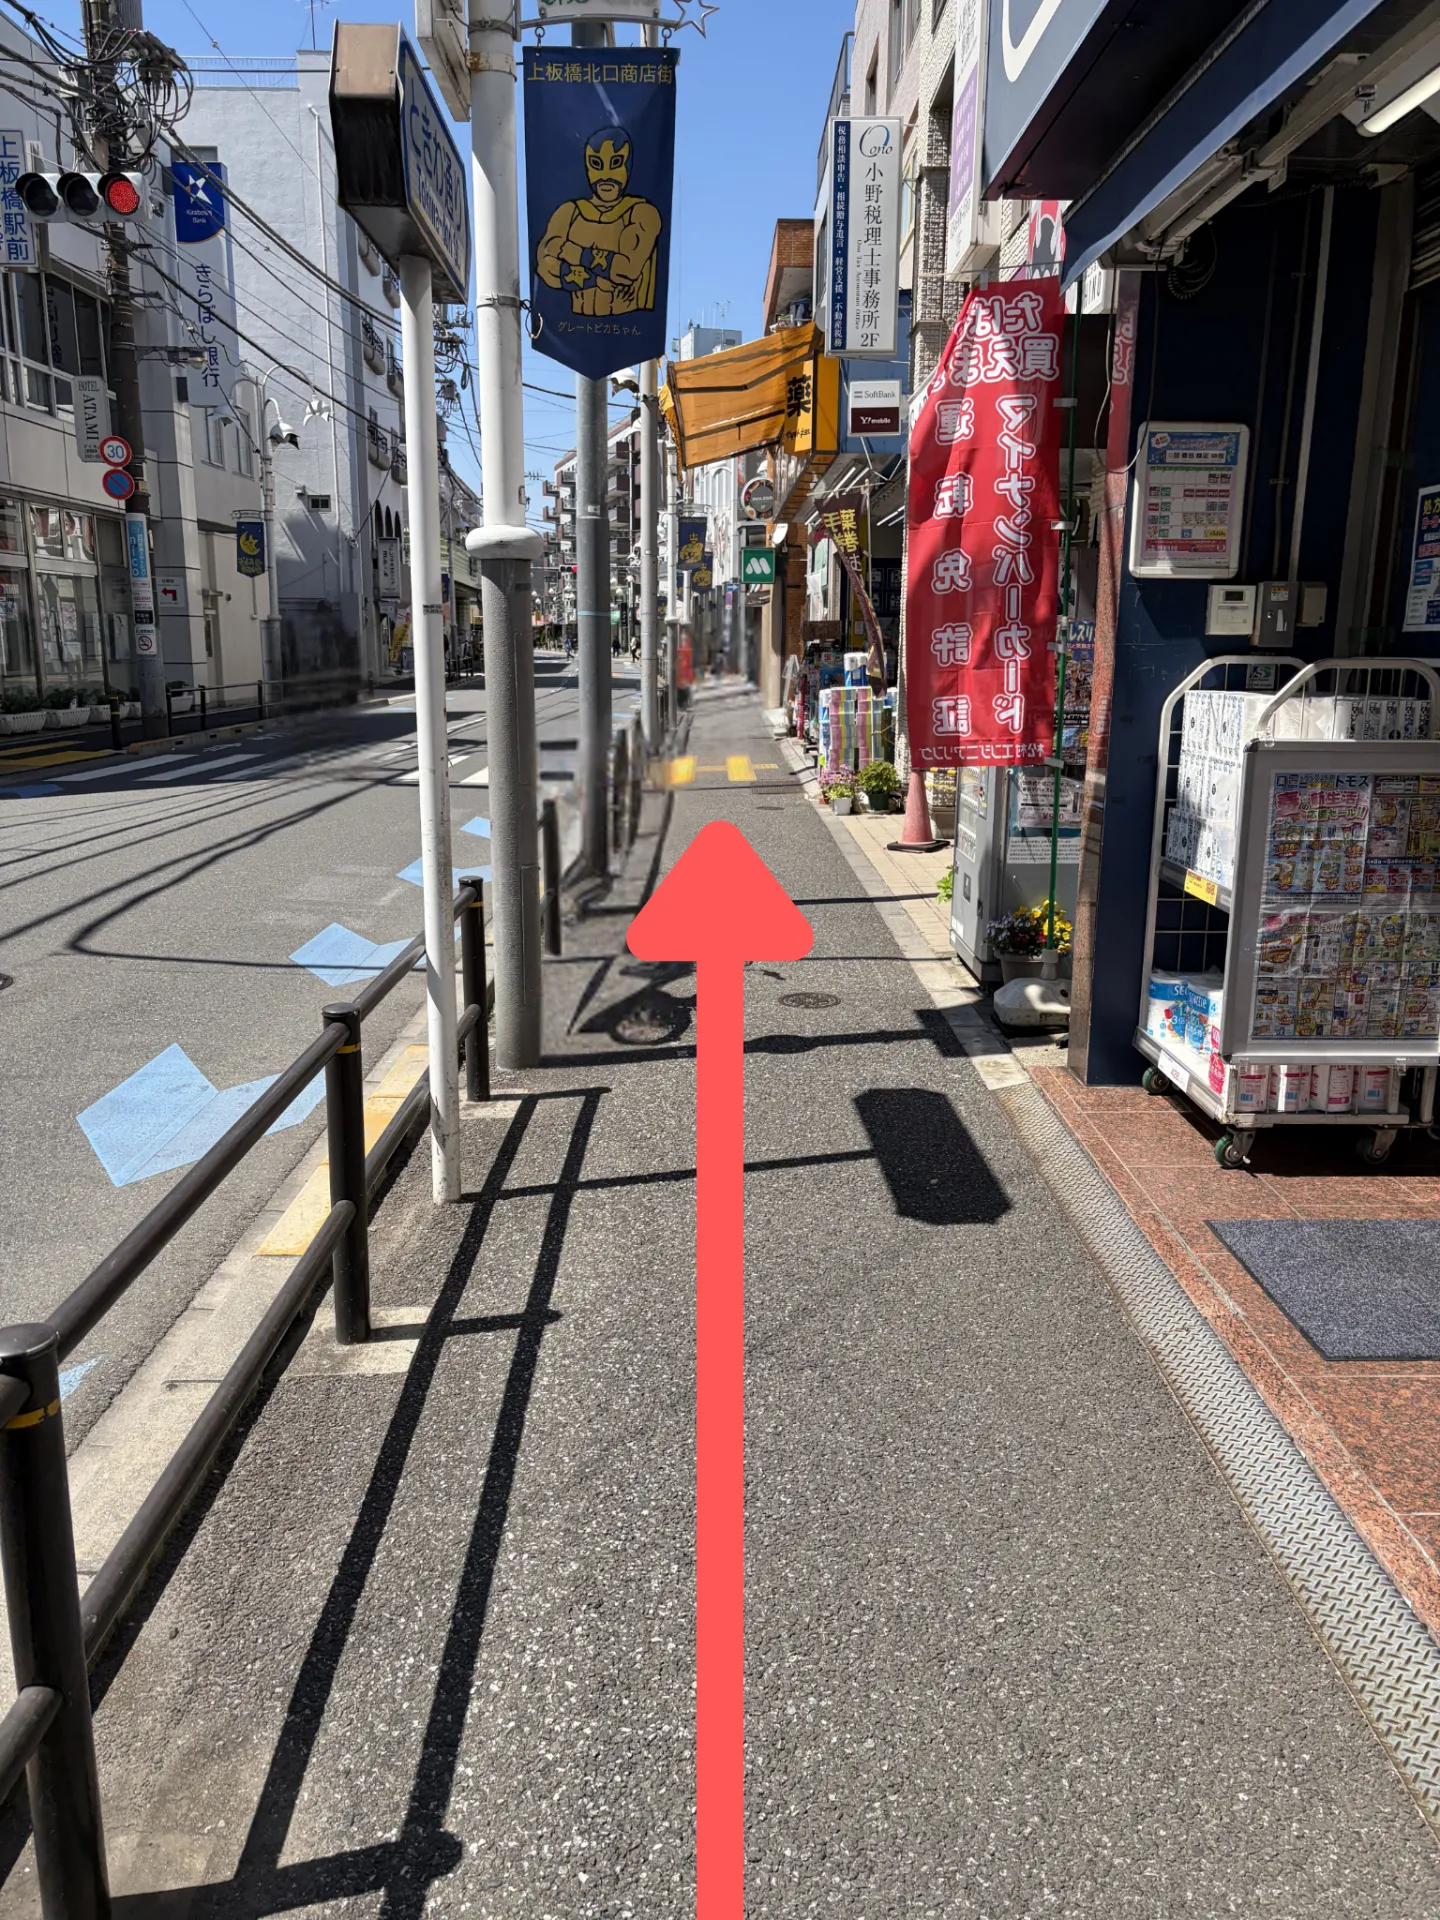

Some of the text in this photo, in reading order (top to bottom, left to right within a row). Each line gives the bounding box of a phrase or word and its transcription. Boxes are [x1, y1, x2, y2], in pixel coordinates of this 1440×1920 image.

[527, 62, 673, 84] 上板橋北口商店街
[409, 78, 462, 231] ときわ通り
[0, 136, 29, 261] 上板橋駅前
[861, 162, 884, 330] 小野税理士事務所
[860, 333, 880, 347] 2F
[83, 394, 99, 440] ATAMI
[787, 373, 812, 418] 薬
[864, 390, 896, 399] SoftBank
[106, 444, 125, 459] 30
